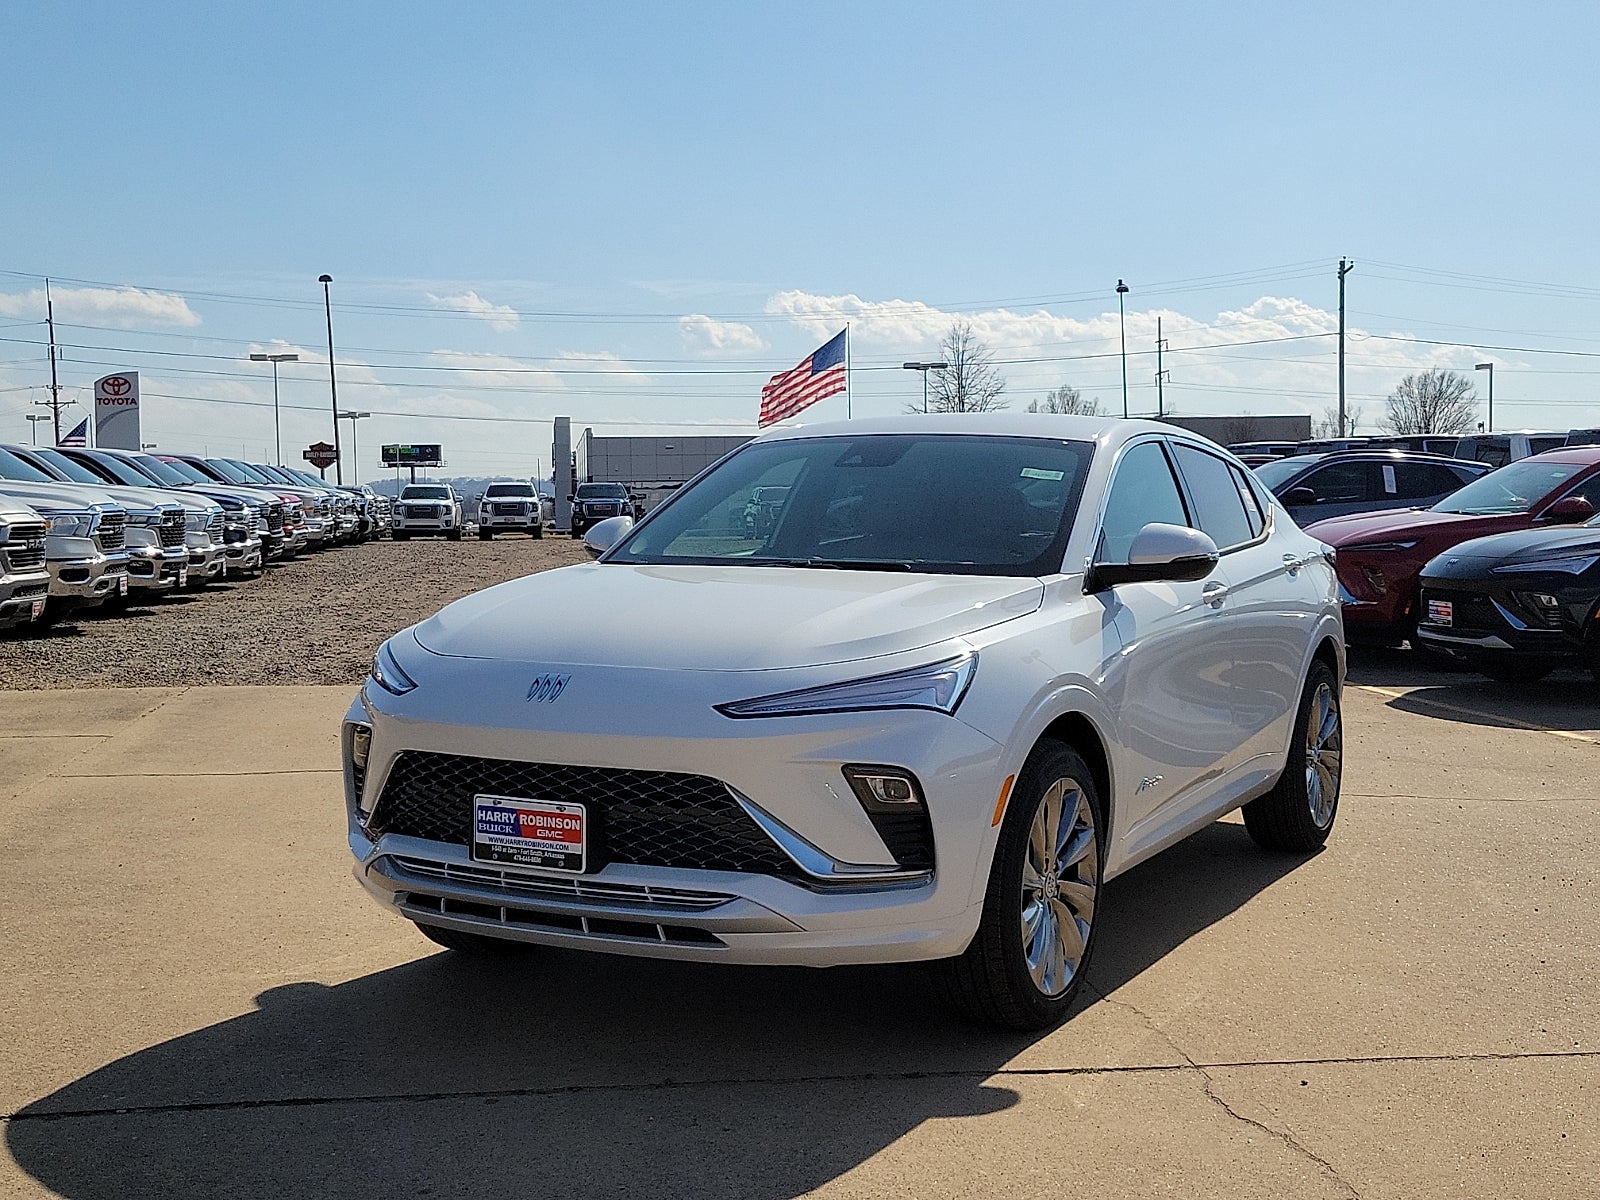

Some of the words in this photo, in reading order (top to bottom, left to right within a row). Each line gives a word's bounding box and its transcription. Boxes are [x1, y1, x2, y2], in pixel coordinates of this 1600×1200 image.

[97, 398, 137, 406] TOYOTA
[478, 810, 516, 824] HARRY
[519, 813, 580, 830] ROBINSON
[478, 823, 514, 834] BUICK
[536, 829, 565, 839] GMC
[488, 836, 569, 851] WWW.HARRYROBINSON.COM
